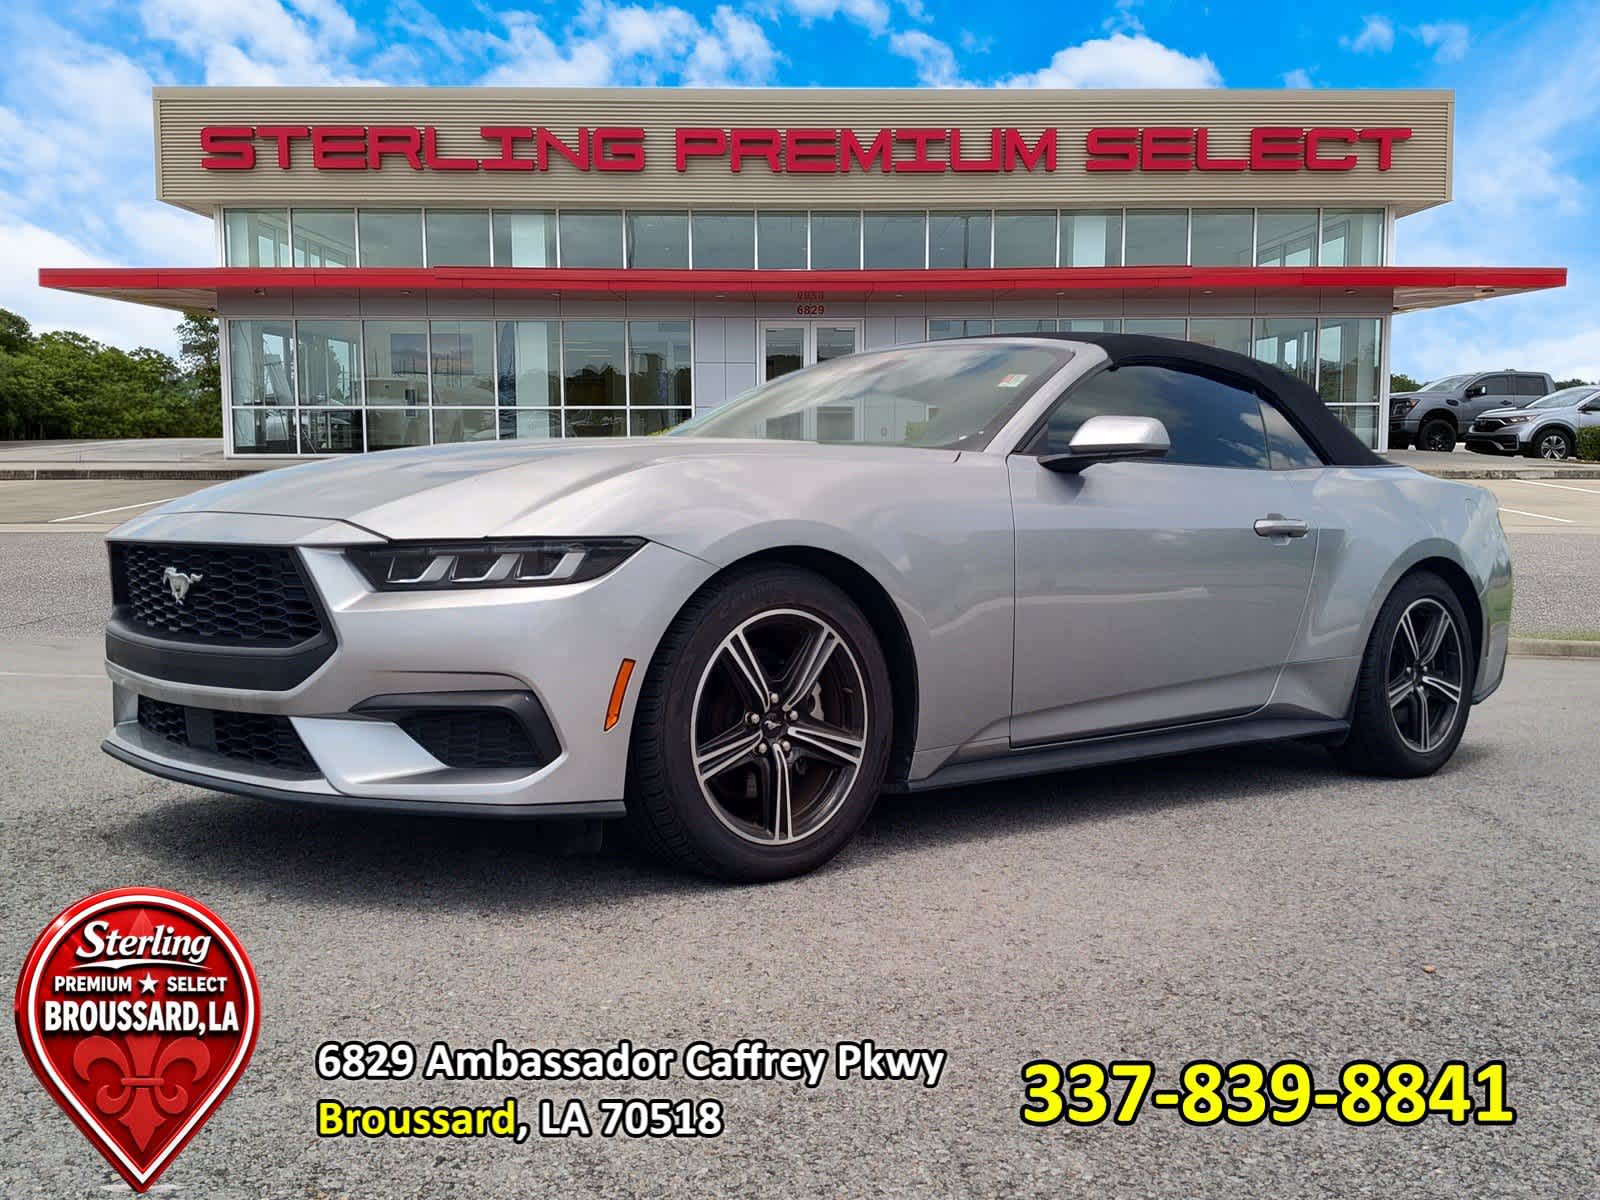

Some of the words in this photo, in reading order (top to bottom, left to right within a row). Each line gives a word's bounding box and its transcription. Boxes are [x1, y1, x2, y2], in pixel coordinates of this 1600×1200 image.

[201, 126, 646, 171] STERLING
[675, 127, 1057, 173] PREMIUM
[1086, 127, 1413, 172] SELECT
[797, 304, 825, 315] 6829
